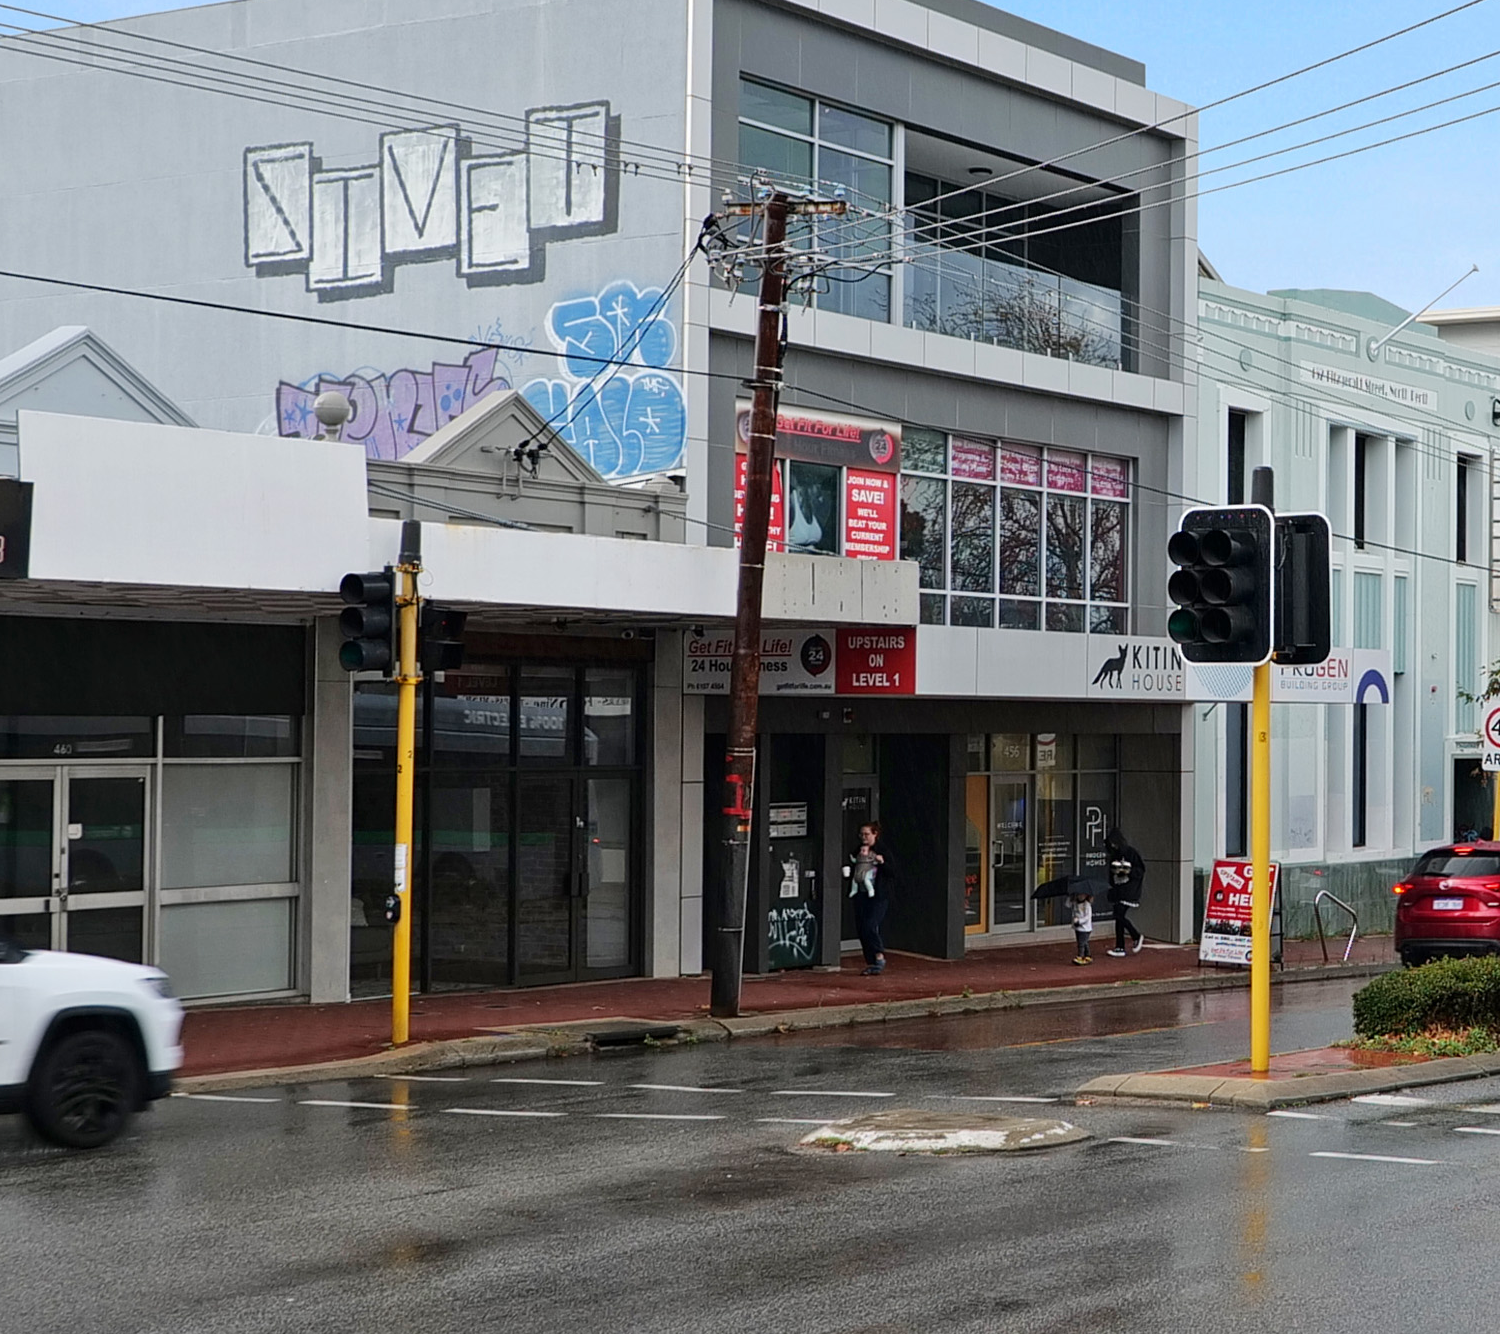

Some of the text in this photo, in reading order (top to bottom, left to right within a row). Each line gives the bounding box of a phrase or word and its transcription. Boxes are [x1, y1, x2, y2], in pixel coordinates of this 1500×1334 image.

[797, 417, 813, 433] Fit
[814, 419, 833, 436] For
[847, 476, 864, 485] JOIN
[865, 478, 882, 487] NOW
[851, 489, 884, 504] SAVE!
[867, 521, 887, 530] YOUR
[851, 531, 884, 542] CURRENT
[688, 639, 793, 654] Get Fit Life!
[848, 635, 905, 649] UPSTAIRS
[808, 650, 824, 662] 24
[869, 654, 884, 668] ON
[1132, 645, 1182, 670] KITIN
[691, 659, 705, 672] 24
[709, 660, 732, 673] Hou
[852, 673, 900, 687] LEVEL 1
[1132, 674, 1182, 692] HOUSE
[1280, 681, 1349, 691] BUILDING GROUP
[1260, 731, 1267, 743] 3
[53, 743, 72, 755] 460
